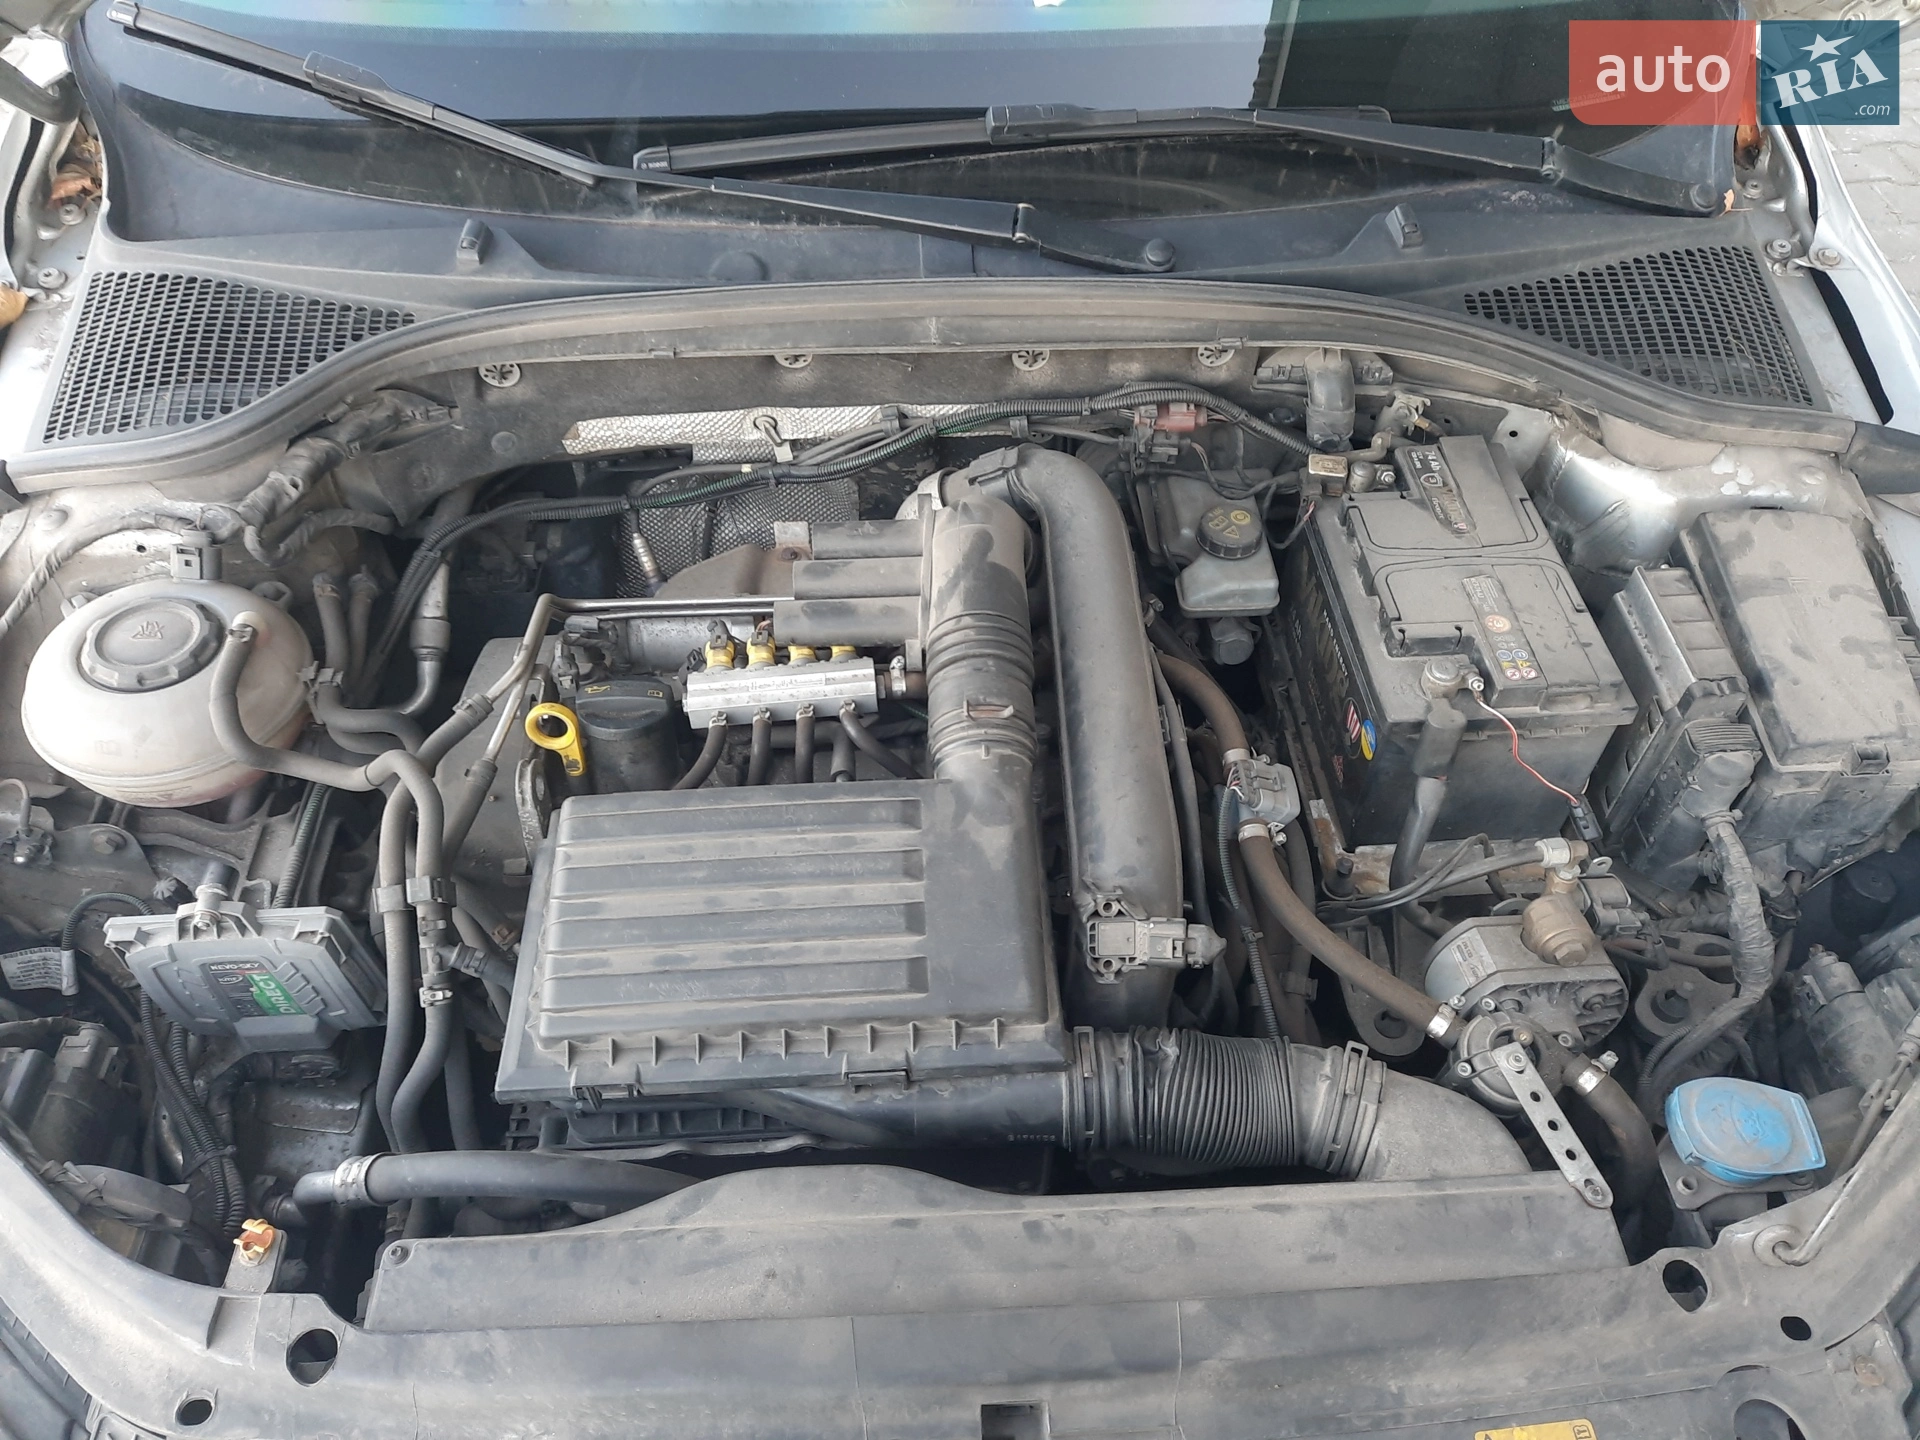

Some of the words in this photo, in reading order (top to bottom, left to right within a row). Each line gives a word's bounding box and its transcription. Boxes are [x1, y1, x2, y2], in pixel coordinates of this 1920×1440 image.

[1424, 450, 1437, 460] 74
[1428, 460, 1442, 471] Ah
[252, 973, 297, 1014] DIRECT
